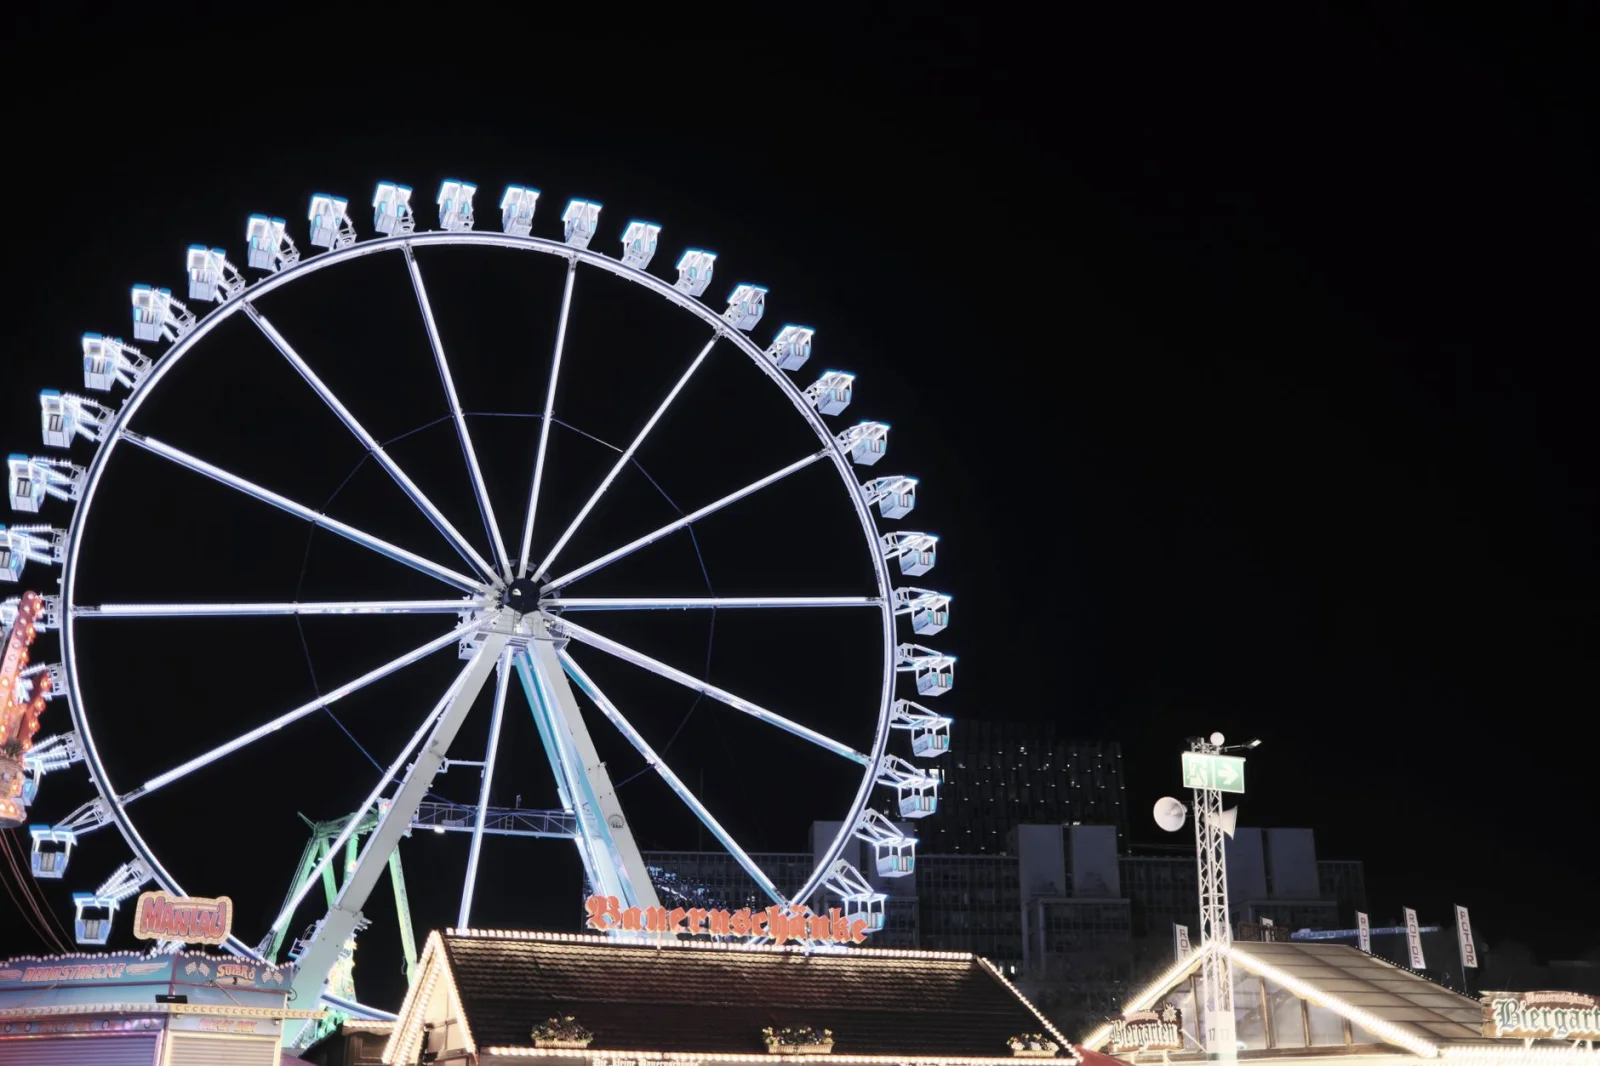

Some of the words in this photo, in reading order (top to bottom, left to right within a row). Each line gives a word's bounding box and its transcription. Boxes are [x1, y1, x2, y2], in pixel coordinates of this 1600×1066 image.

[584, 894, 869, 945] Bauernschänke
[1408, 913, 1422, 966] ROTOR
[1110, 1019, 1179, 1053] Biergarten
